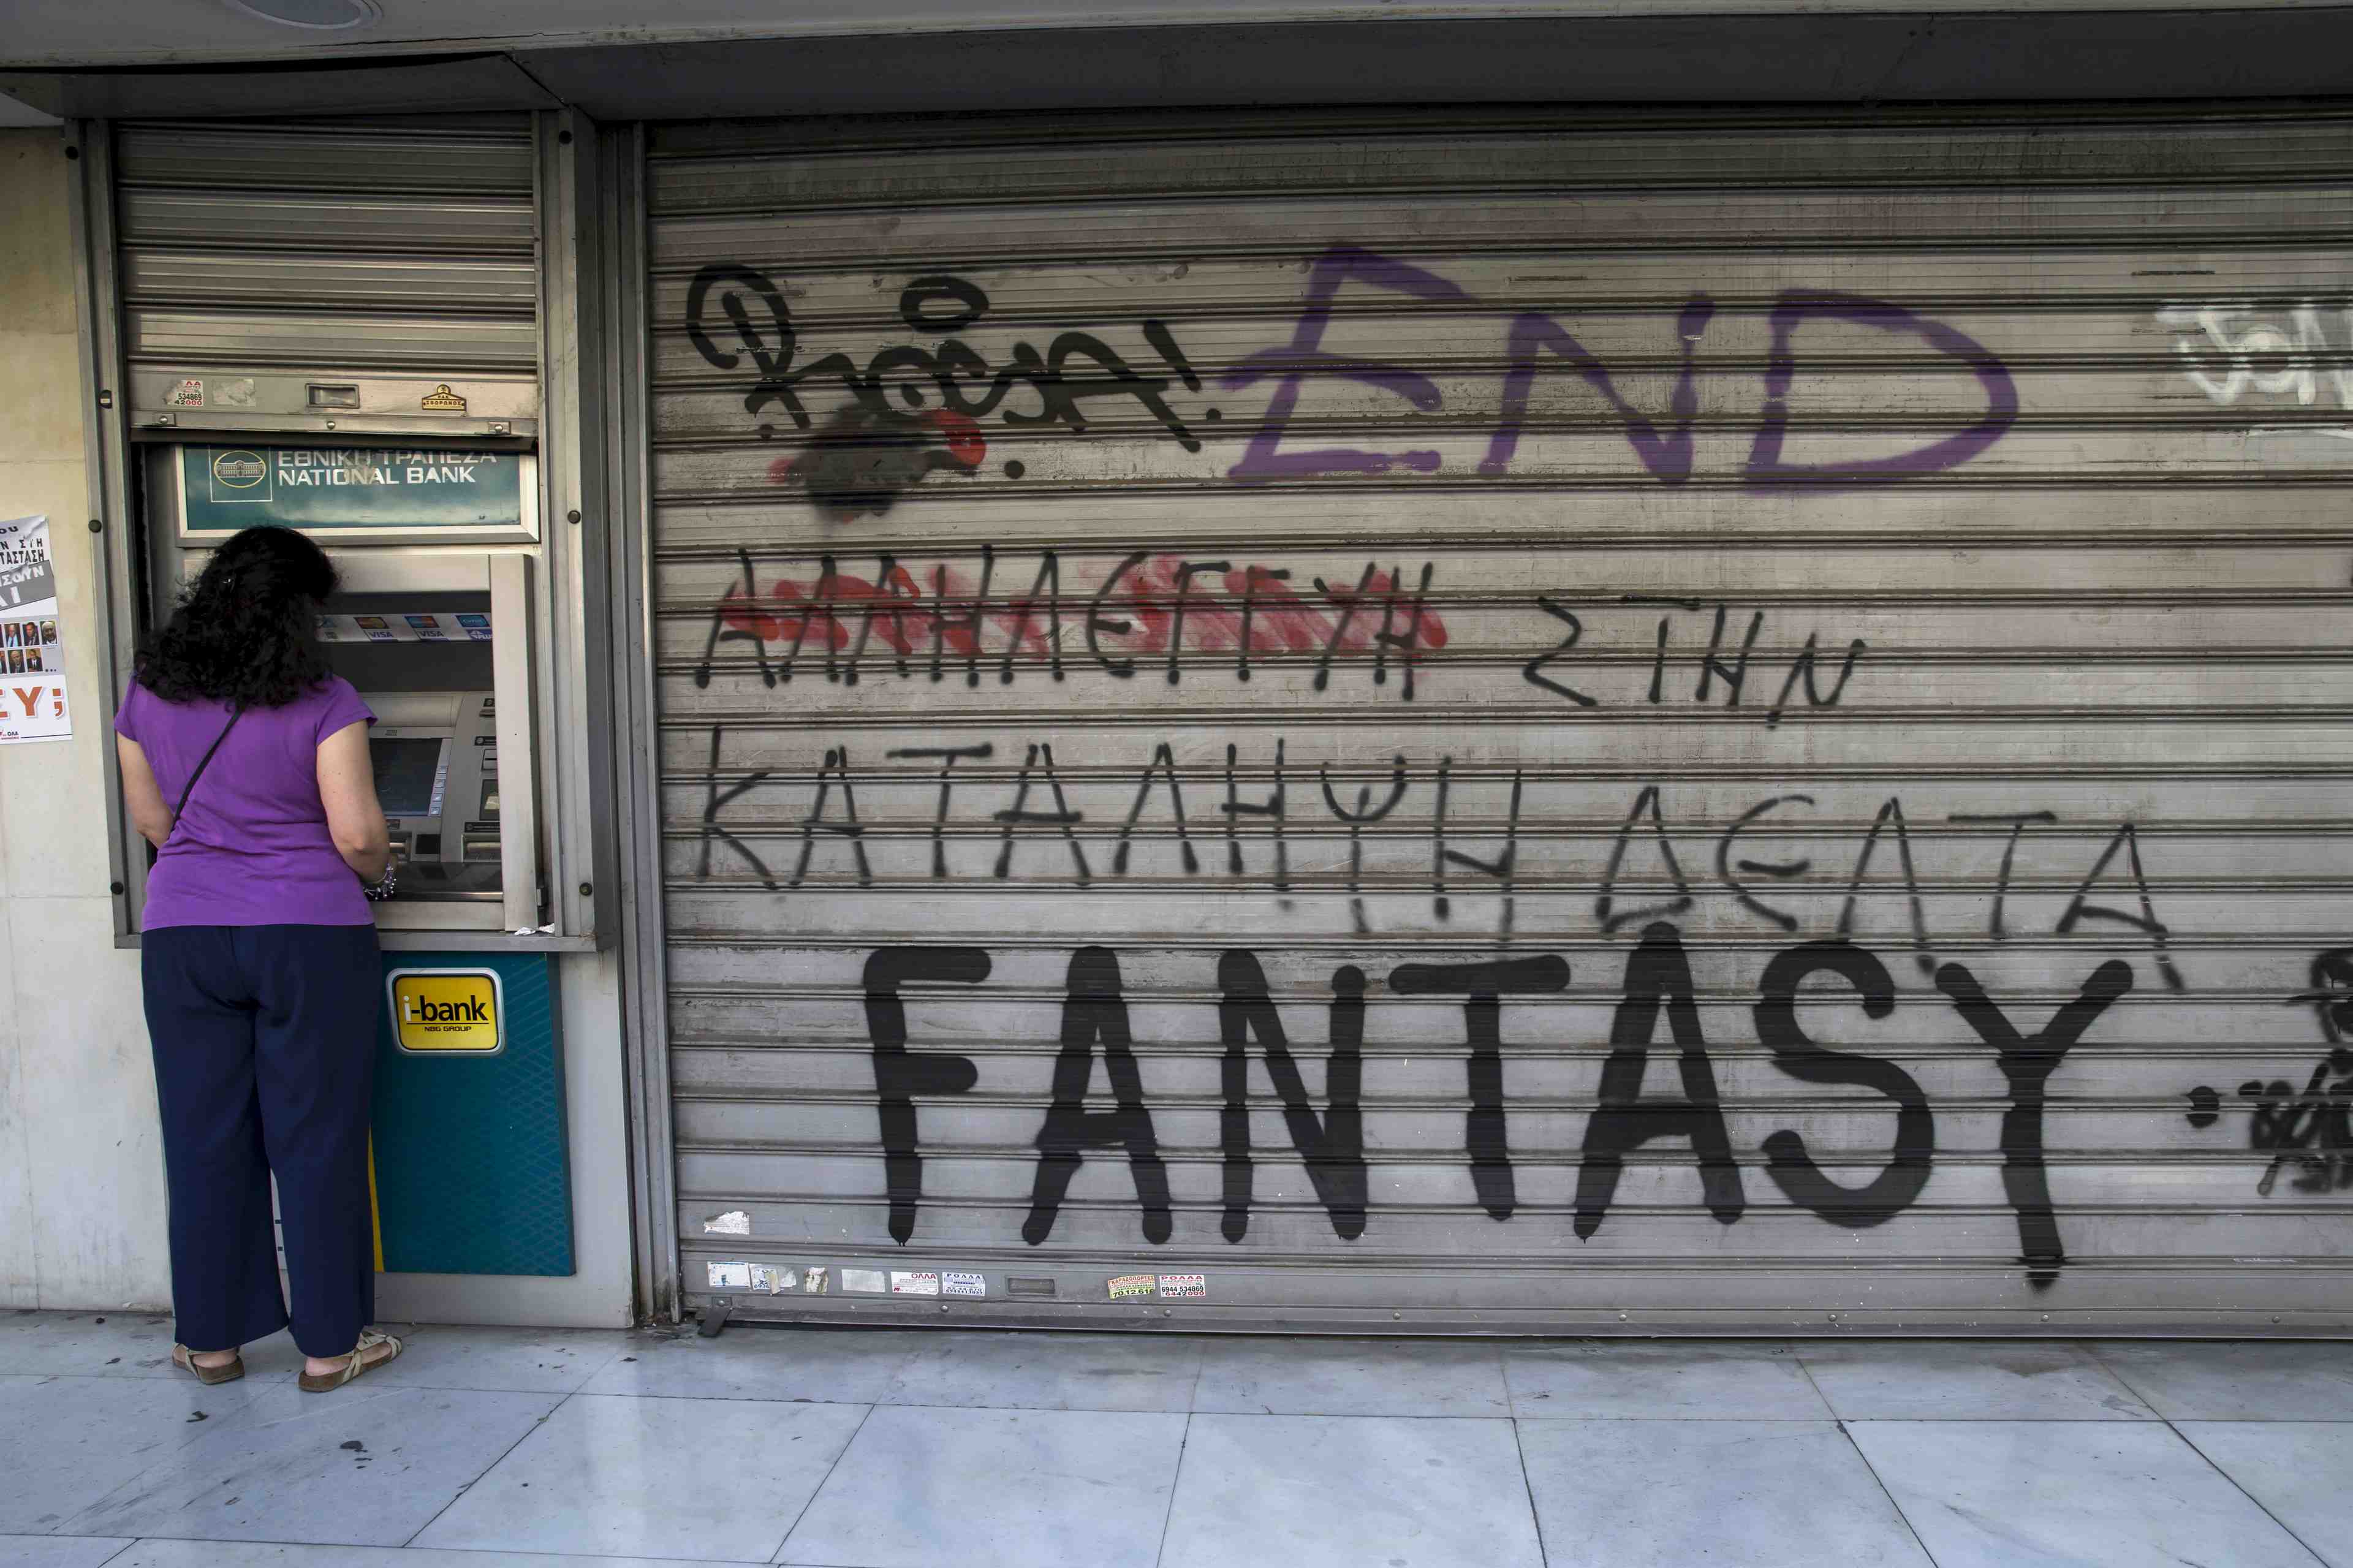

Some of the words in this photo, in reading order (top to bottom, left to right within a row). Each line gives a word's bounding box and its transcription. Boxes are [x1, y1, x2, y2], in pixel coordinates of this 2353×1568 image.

[278, 467, 400, 486] NATIONAL
[406, 466, 476, 485] BANK
[403, 995, 488, 1021] i-bank
[863, 921, 2134, 1290] FANTASY
